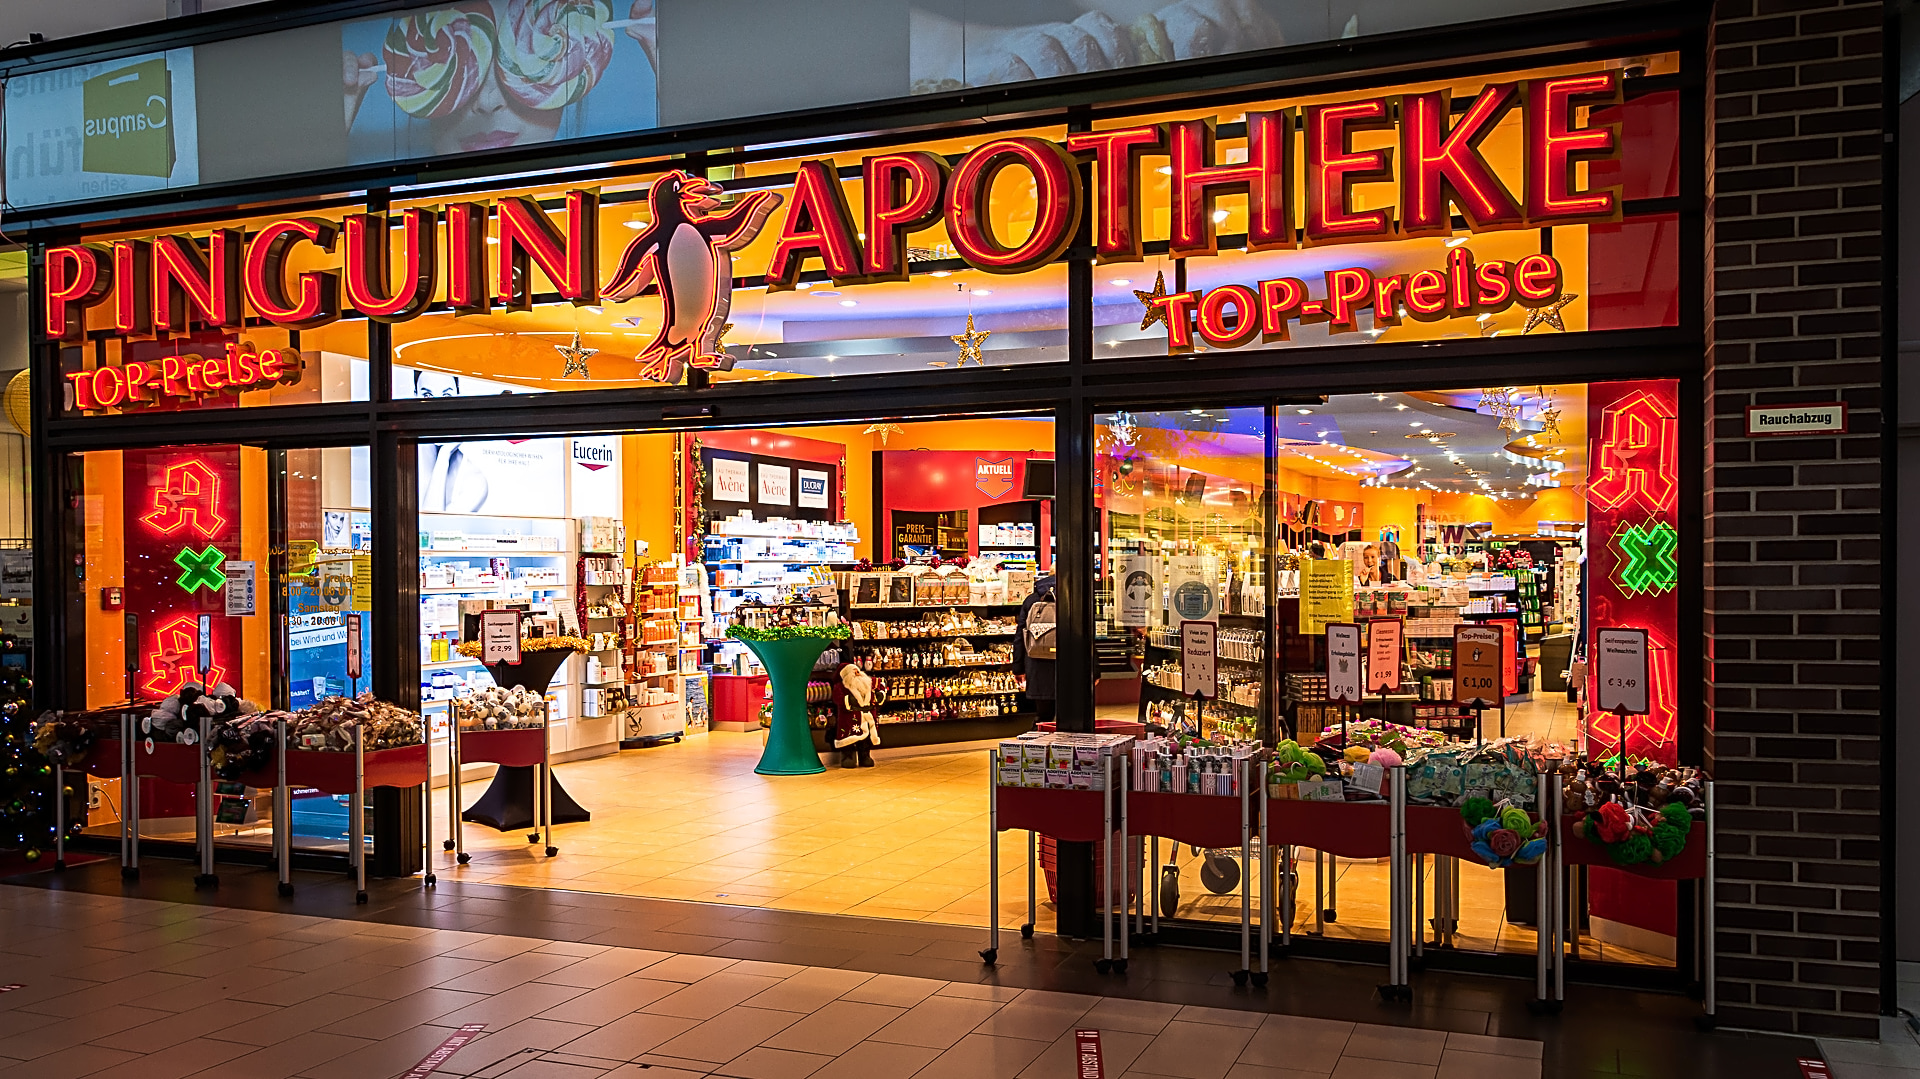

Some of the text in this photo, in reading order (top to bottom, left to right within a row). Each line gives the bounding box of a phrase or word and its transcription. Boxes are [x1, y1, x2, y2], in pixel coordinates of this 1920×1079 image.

[764, 73, 1622, 284] APOTHEKE
[45, 189, 598, 340] PINGUIN
[1153, 245, 1561, 351] TOP-Preise
[66, 341, 288, 411] TOP-Preise
[1760, 413, 1832, 425] Rauchabzug
[573, 440, 613, 462] Eucerin
[978, 465, 1012, 475] AKTUELL
[716, 475, 745, 492] Avène
[762, 480, 786, 496] Avène
[803, 480, 822, 490] DUCRAY
[906, 524, 925, 534] PREIS
[898, 534, 932, 544] GARANTIE
[280, 574, 316, 585] Montag
[324, 574, 358, 584] Freitag
[282, 586, 302, 596] 8.00
[310, 586, 335, 596] 20.00
[338, 586, 356, 596] Uhr
[298, 603, 340, 614] Samstag
[311, 616, 336, 626] 20.00
[291, 638, 300, 646] bei
[303, 635, 321, 644] Wind
[322, 632, 336, 641] und
[1187, 648, 1211, 656] Reduziert
[1463, 677, 1492, 689] € 1,00
[1608, 678, 1636, 688] € 3,49
[1341, 686, 1353, 694] 1,49
[446, 1037, 468, 1046] MIT
[414, 1047, 455, 1072] ABSTAND
[1081, 1043, 1099, 1078] MIT ABSTAND
